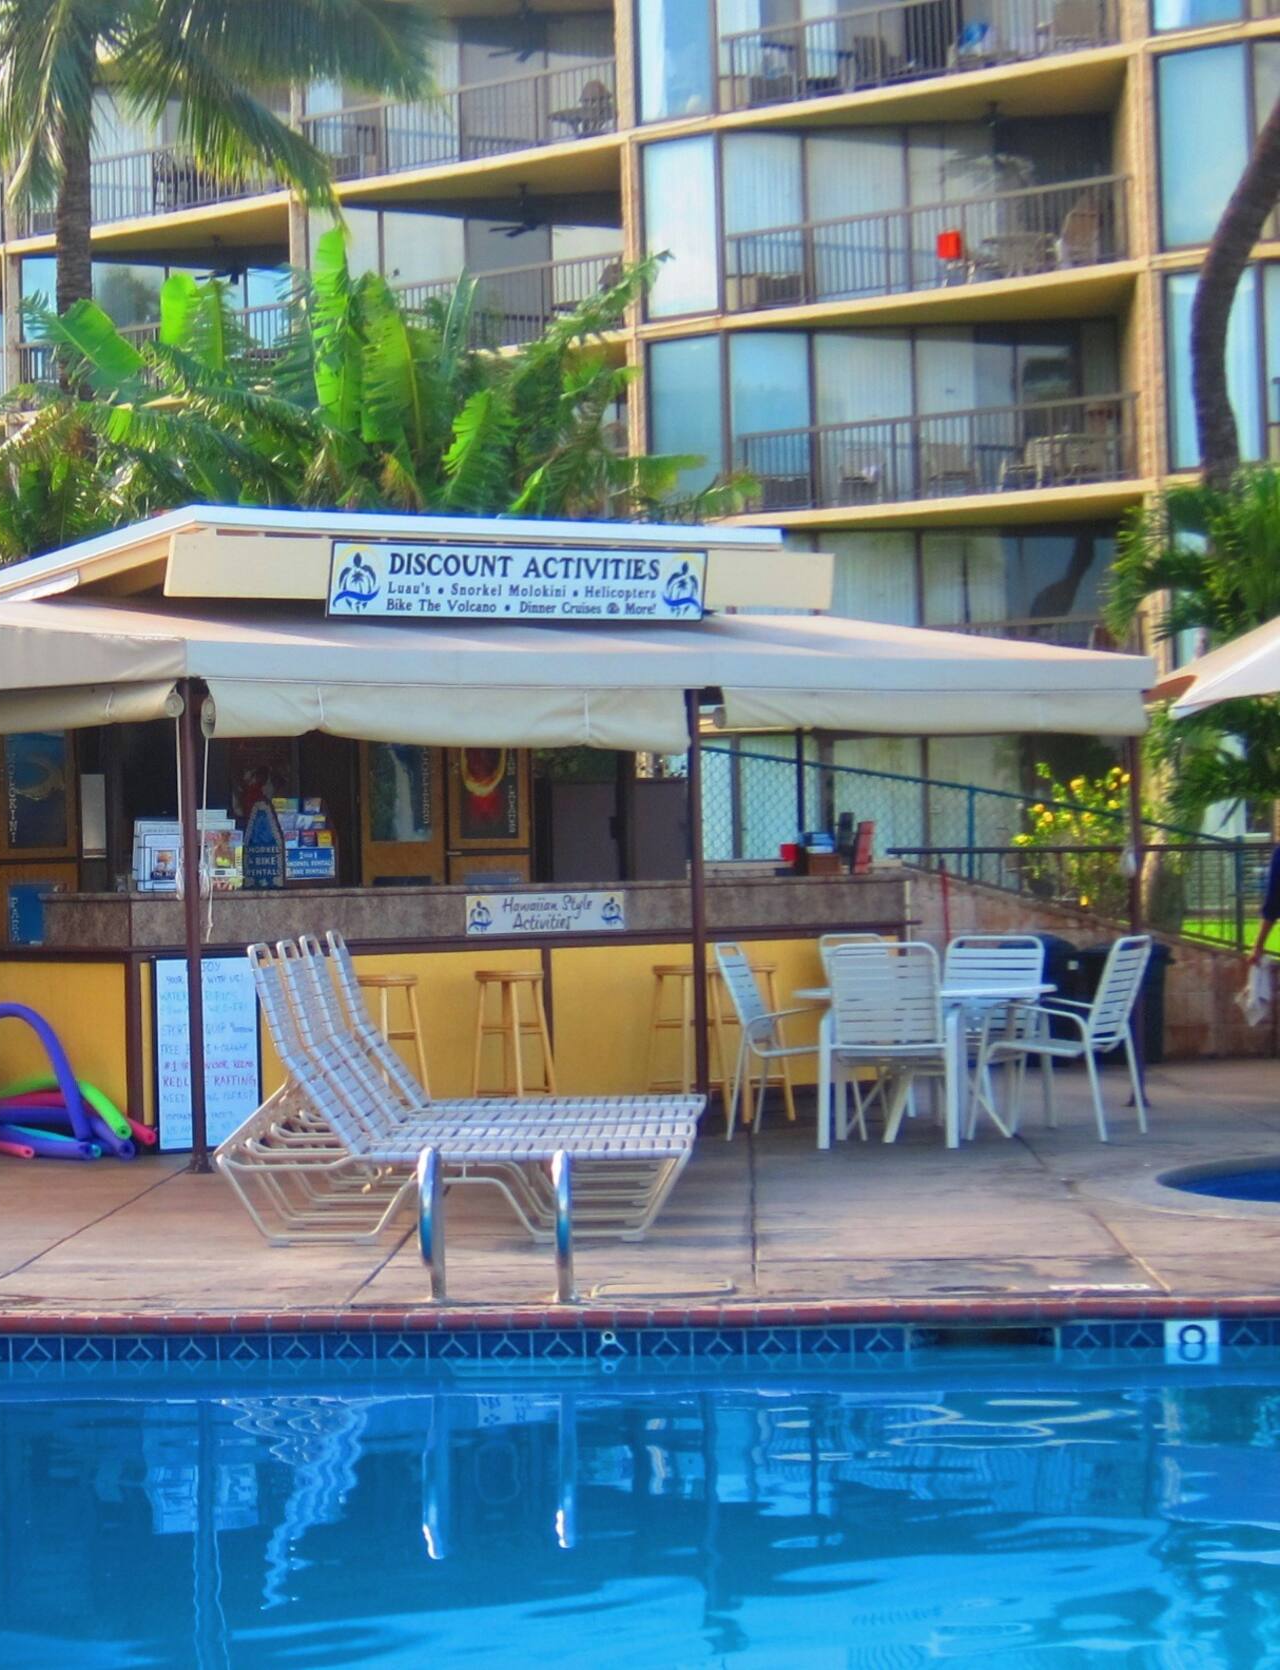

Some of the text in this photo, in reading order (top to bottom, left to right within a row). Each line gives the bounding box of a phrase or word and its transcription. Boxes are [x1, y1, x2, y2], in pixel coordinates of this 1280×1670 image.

[388, 552, 660, 581] DISCOUNT ACTIVITIES
[387, 581, 657, 602] Luau's Snorkel Molokini Helicopters
[386, 598, 412, 612] Bike
[418, 599, 441, 612] The
[446, 599, 497, 613] Volcano
[520, 601, 557, 615] Dinner
[562, 601, 602, 615] Cruises
[625, 602, 657, 616] More!
[255, 857, 276, 865] BIKE
[502, 894, 593, 919] Hawaiian Style
[512, 913, 573, 930] Activities
